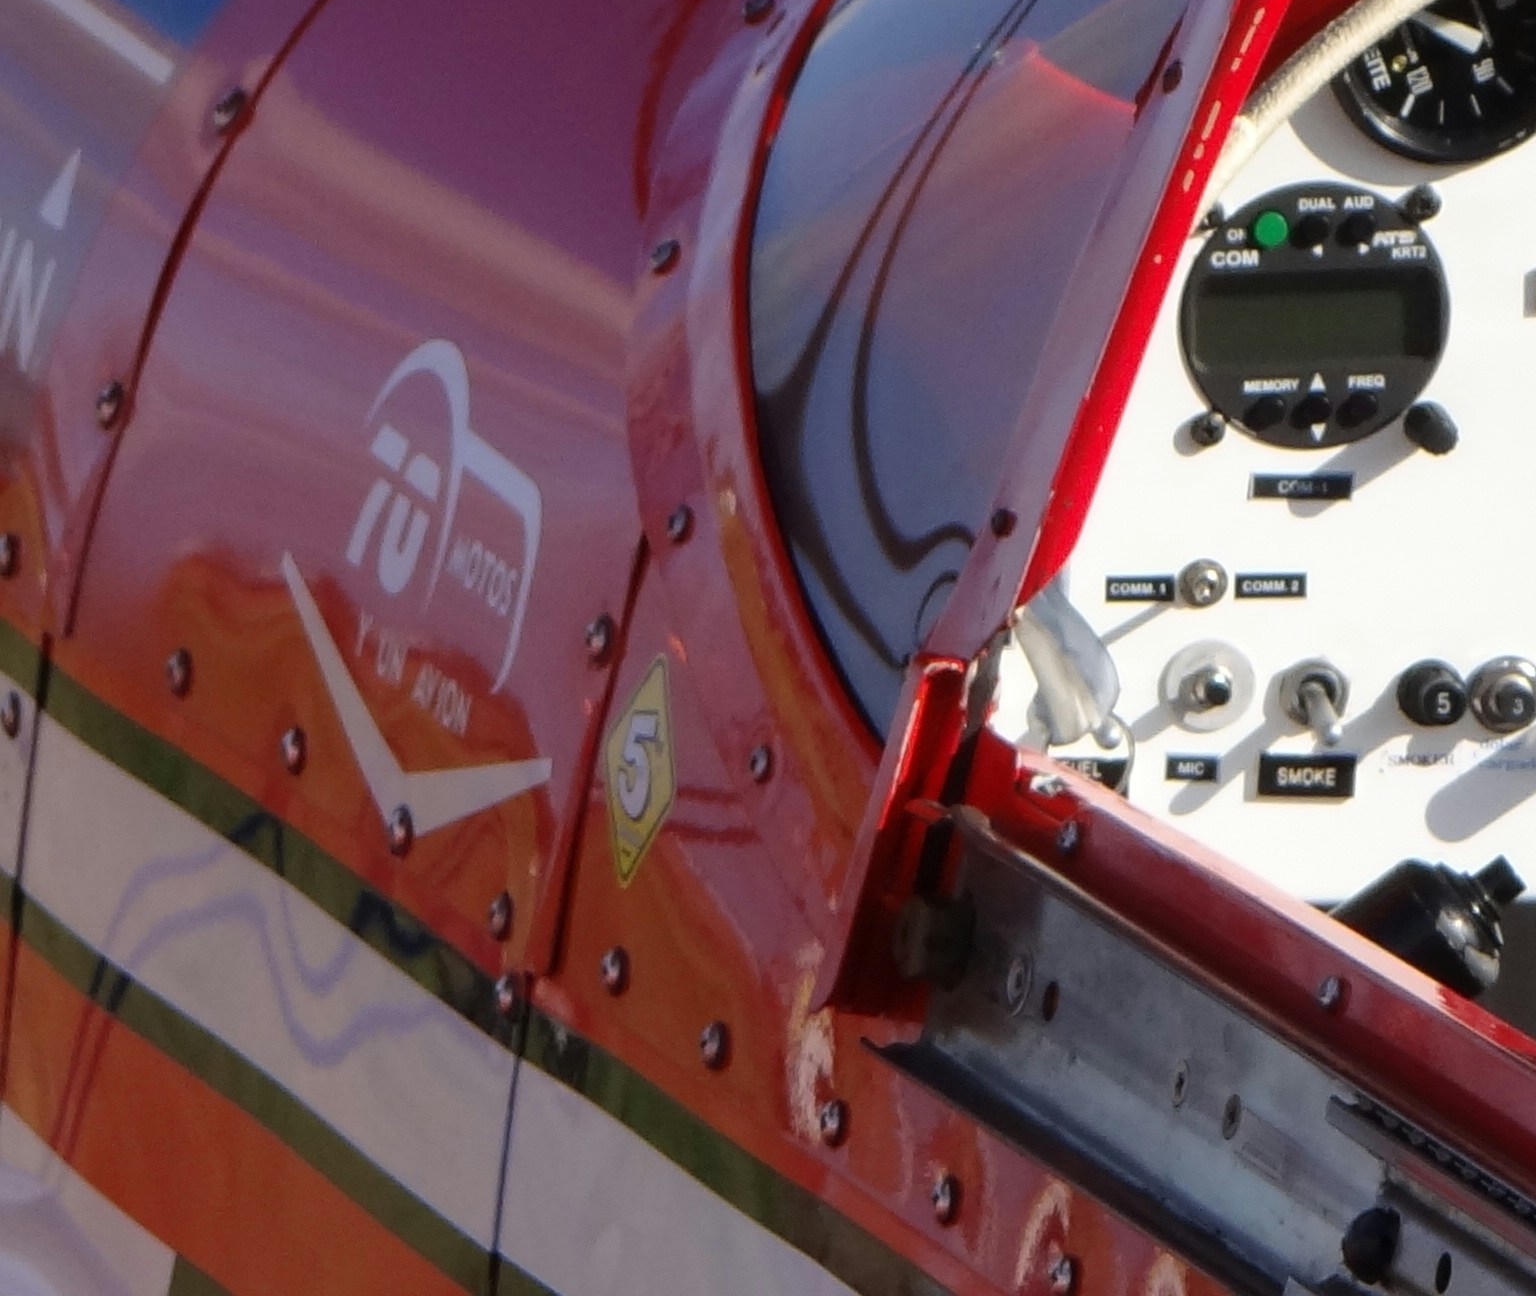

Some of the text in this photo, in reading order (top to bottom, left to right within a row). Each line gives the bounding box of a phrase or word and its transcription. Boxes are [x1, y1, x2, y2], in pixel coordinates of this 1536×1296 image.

[1297, 196, 1336, 212] DUAL
[1210, 250, 1260, 268] COM
[1242, 377, 1300, 393] MEMORY
[1347, 373, 1386, 391] FREQ
[1437, 691, 1452, 714] 5
[1512, 698, 1524, 715] 3
[617, 709, 660, 821] 5
[1177, 761, 1204, 775] MIC
[1276, 767, 1338, 787] SMOKE
